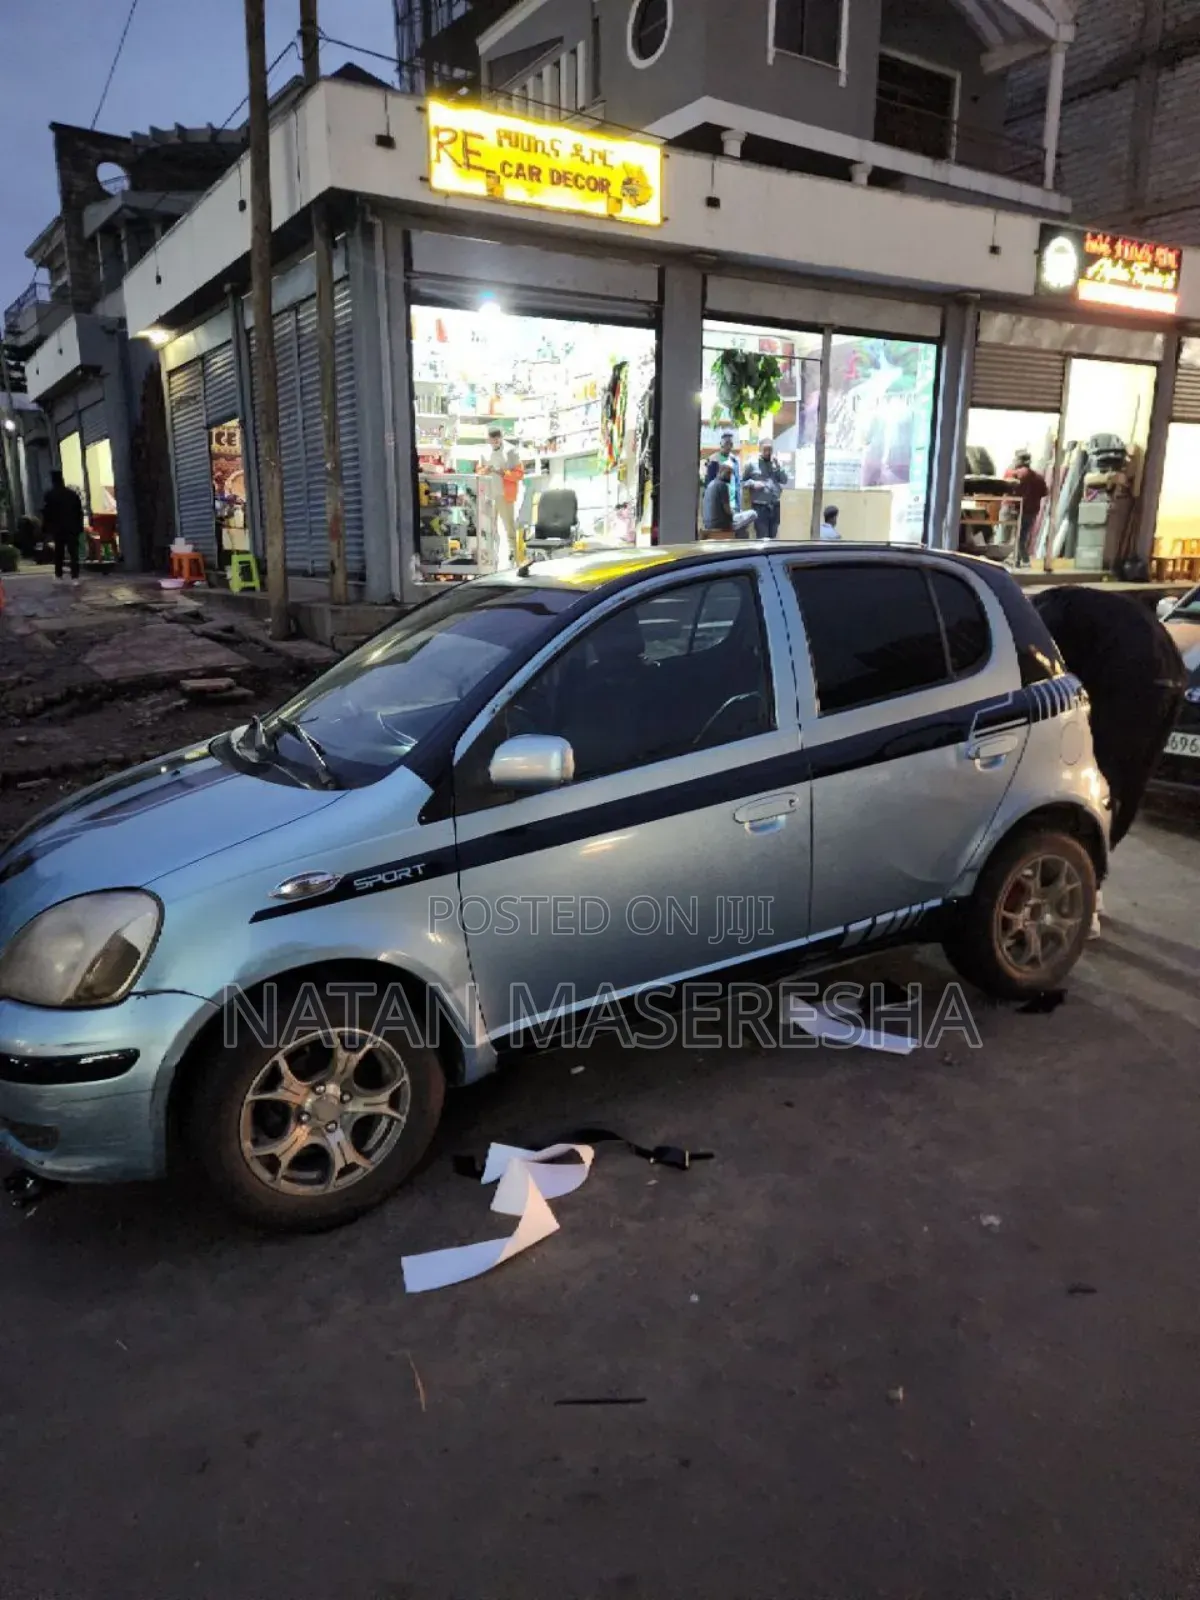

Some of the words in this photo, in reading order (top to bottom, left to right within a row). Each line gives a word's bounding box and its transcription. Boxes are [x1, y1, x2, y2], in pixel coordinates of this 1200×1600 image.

[432, 126, 495, 174] RE
[500, 160, 542, 184] CAR
[550, 168, 612, 195] DECOR
[1170, 736, 1200, 754] 696
[353, 863, 426, 891] SPORT
